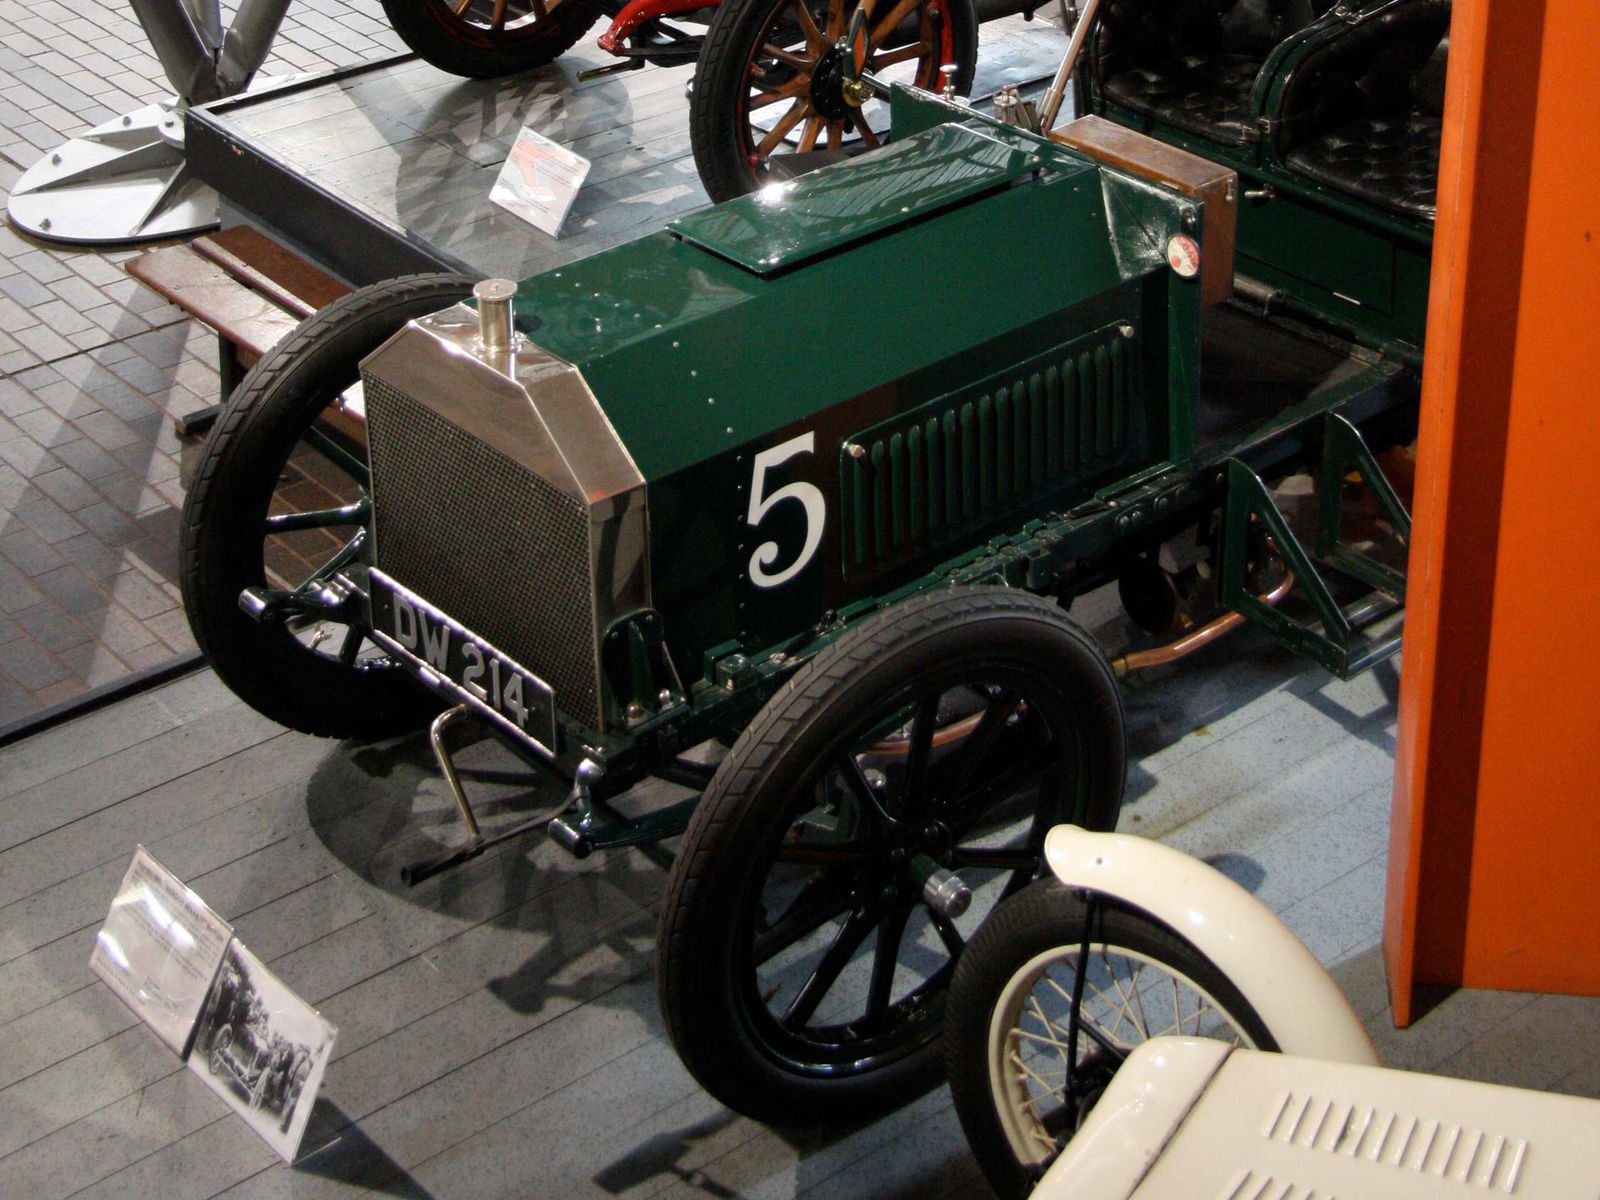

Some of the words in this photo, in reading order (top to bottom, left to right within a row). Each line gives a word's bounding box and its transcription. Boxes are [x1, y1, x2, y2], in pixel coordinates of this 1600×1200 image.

[747, 430, 826, 588] 5
[393, 591, 450, 673] DW
[461, 642, 530, 729] 214
